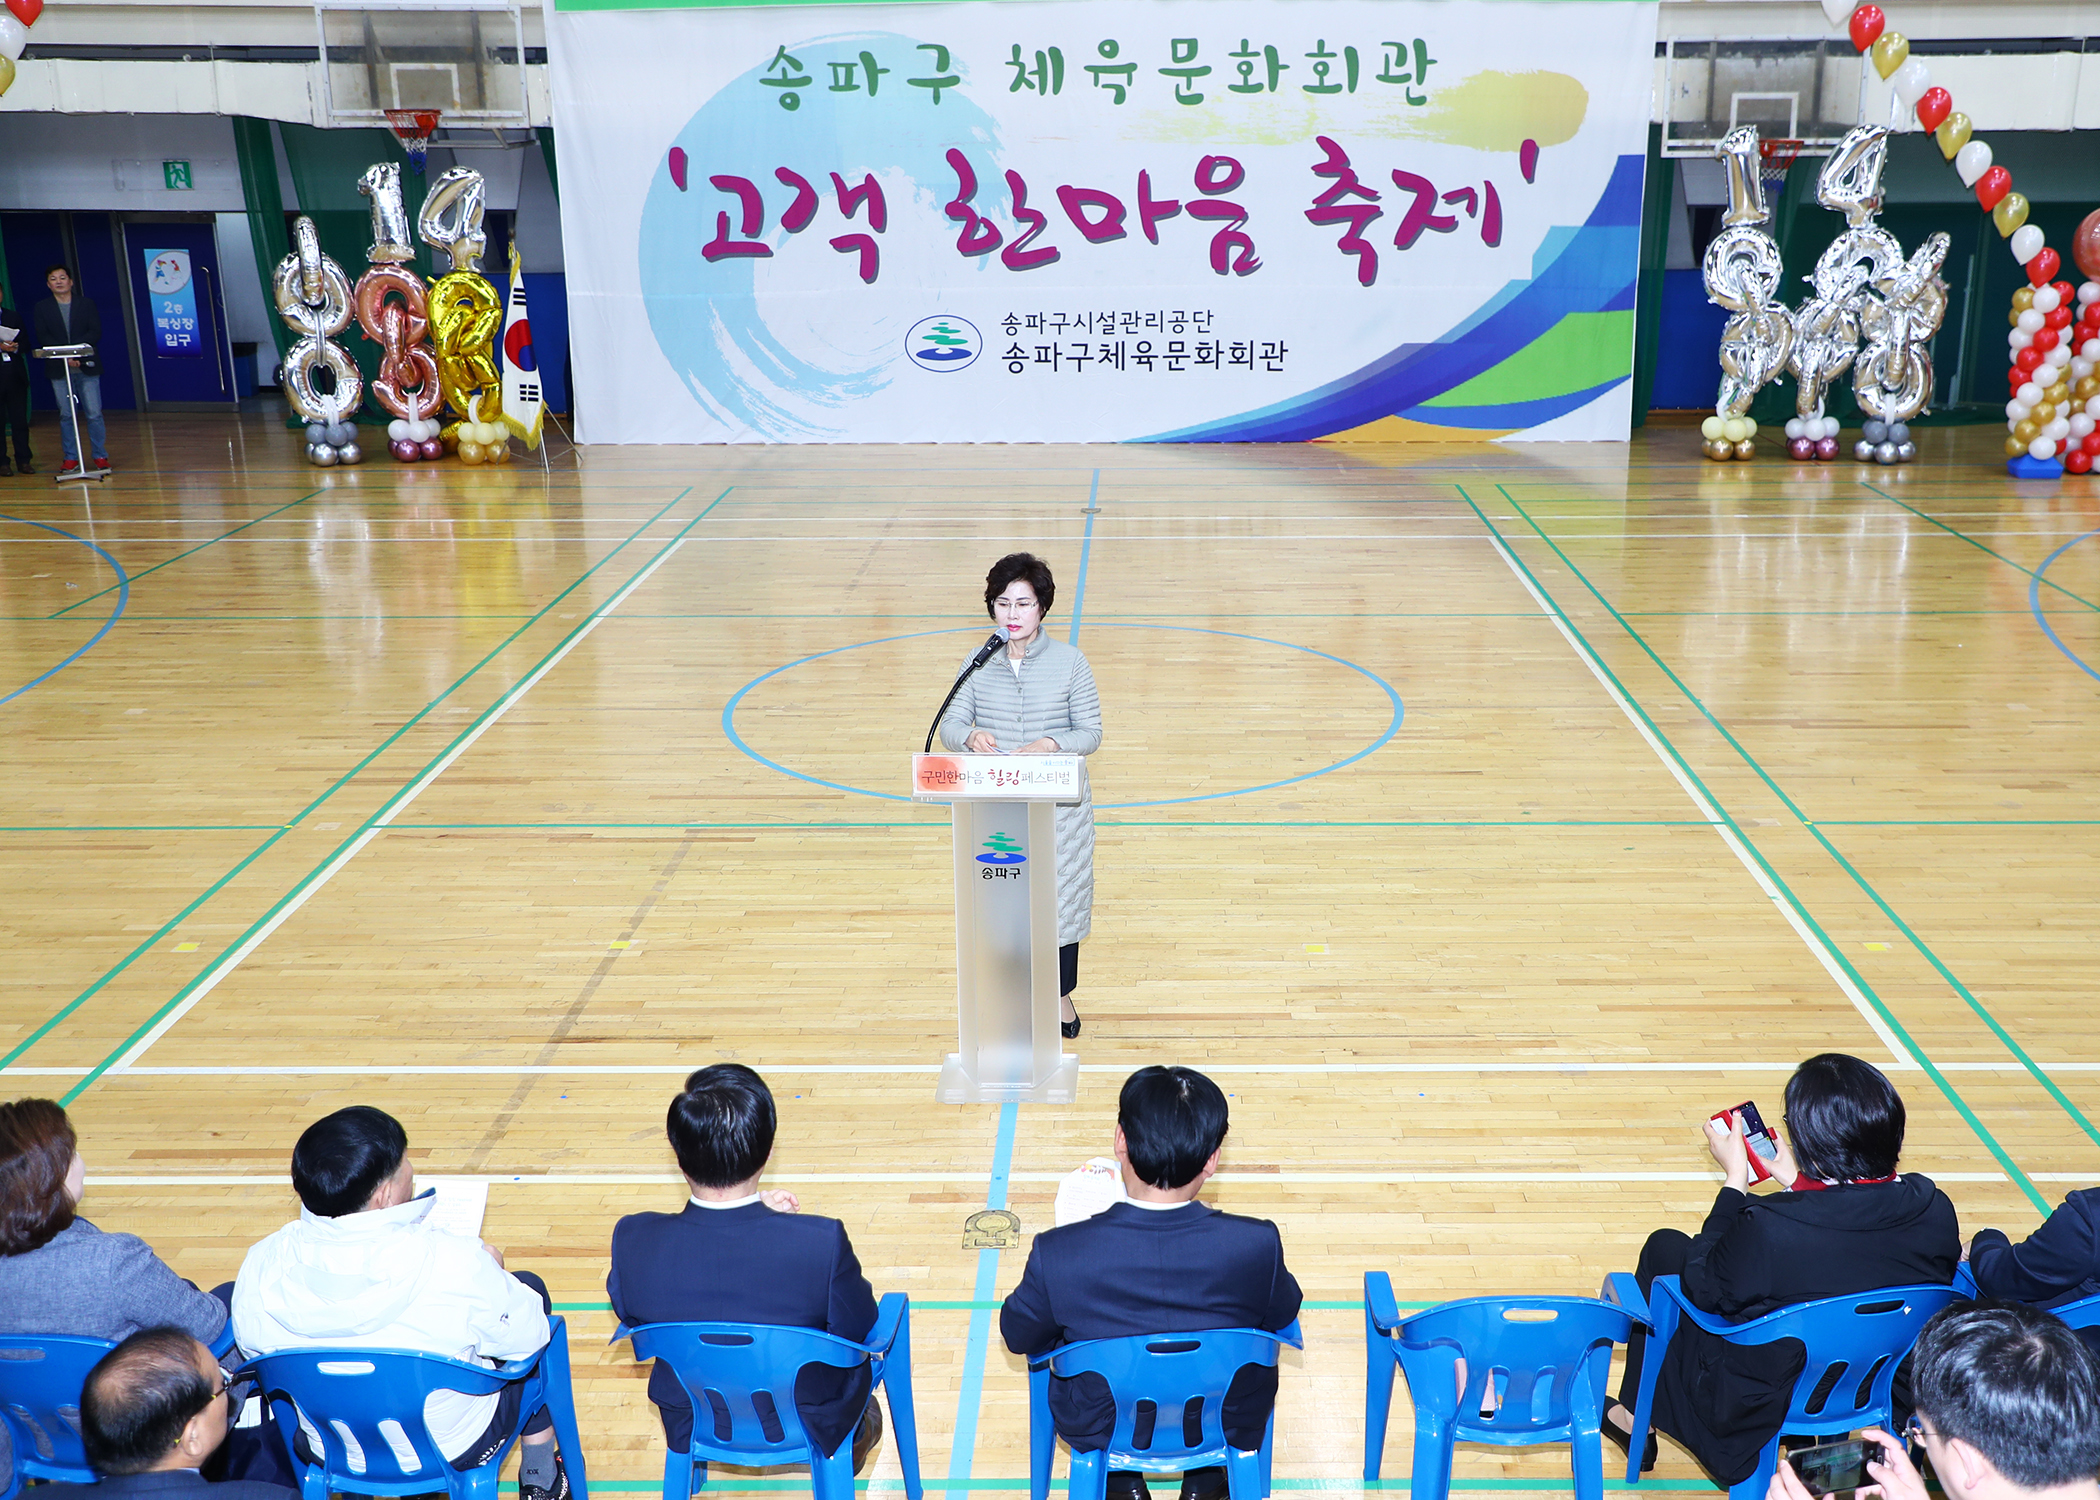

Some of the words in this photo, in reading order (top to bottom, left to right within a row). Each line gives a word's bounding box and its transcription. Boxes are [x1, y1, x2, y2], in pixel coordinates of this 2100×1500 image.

[760, 45, 961, 112] 송파구
[1006, 38, 1437, 108] 체육문화회관
[945, 148, 1263, 276] 한마음
[163, 300, 184, 315] 2층
[157, 317, 195, 331] 복싱장
[1000, 309, 1214, 337] 송파구시설관리공단
[164, 333, 192, 347] 입구
[1001, 339, 1290, 374] 송파구체육문화회관
[921, 769, 985, 785] 구민한마음
[981, 867, 1021, 880] 송파구
